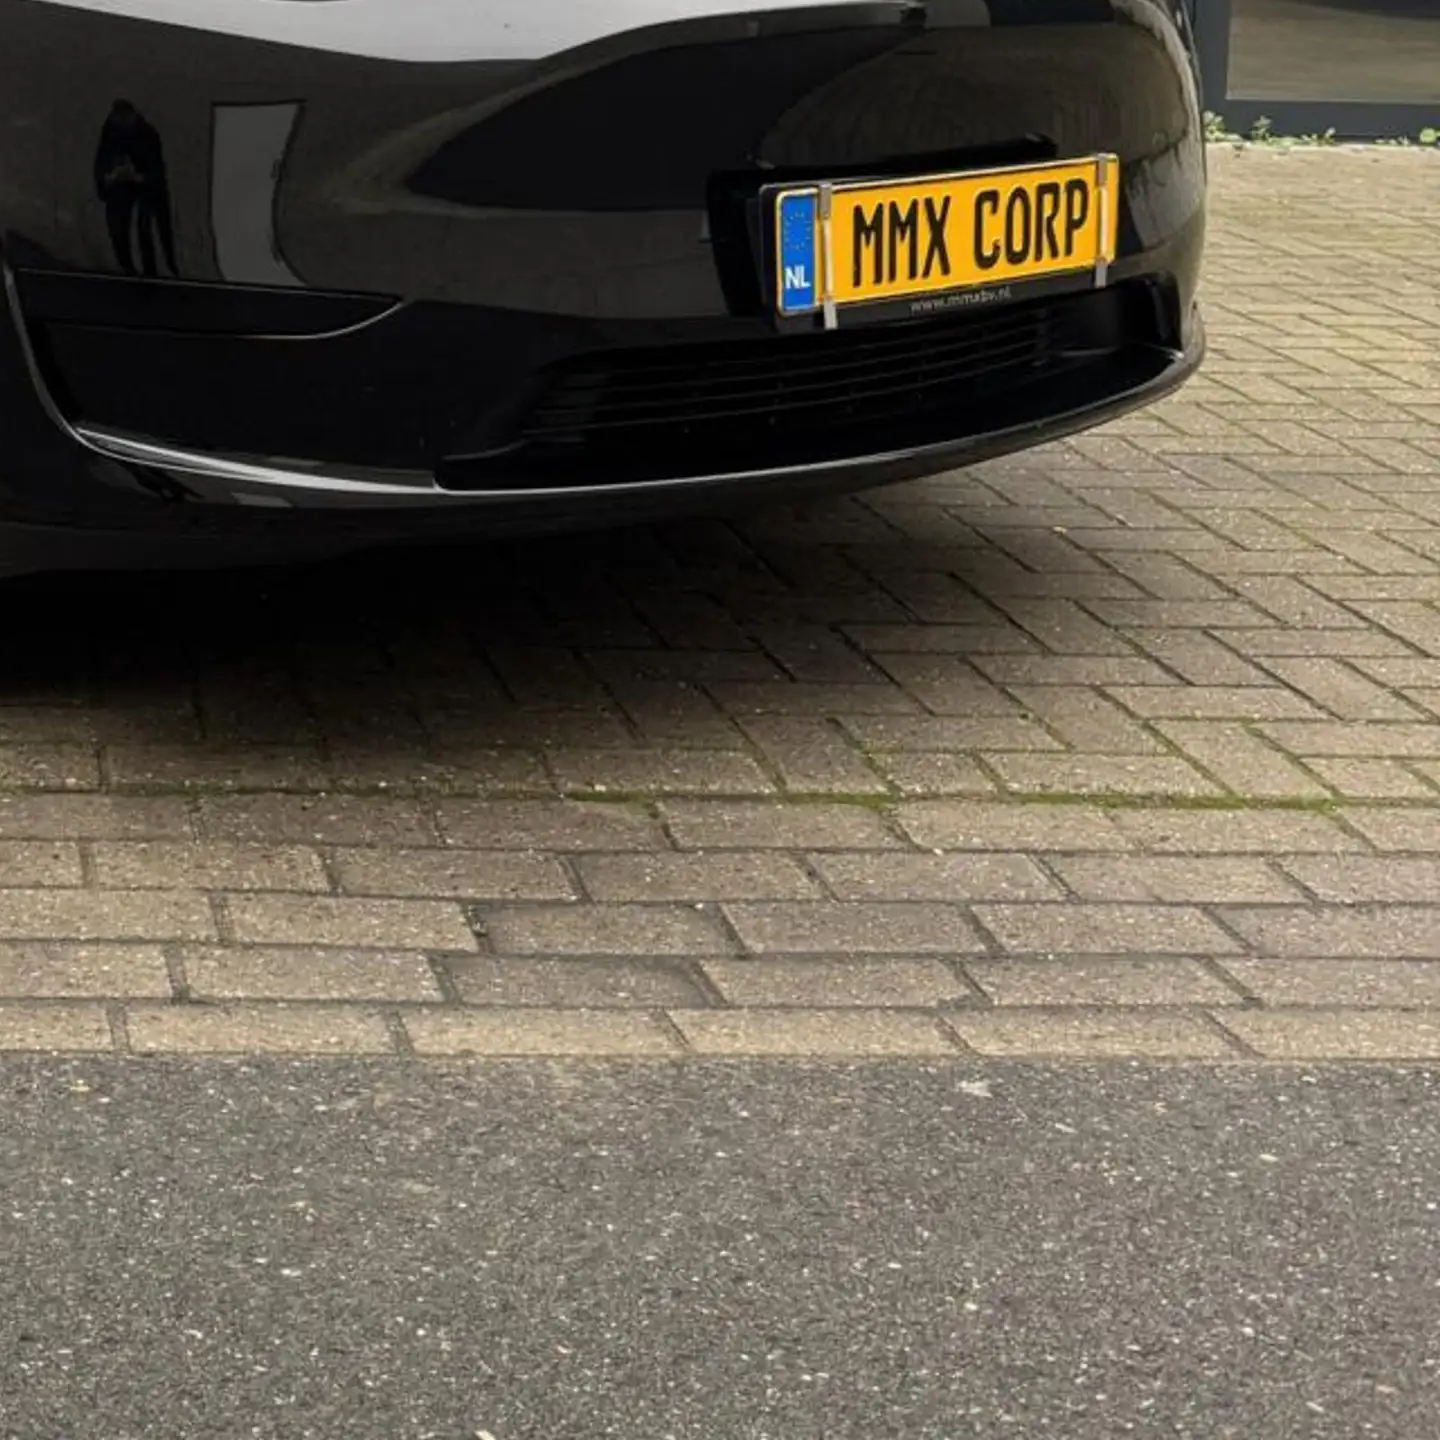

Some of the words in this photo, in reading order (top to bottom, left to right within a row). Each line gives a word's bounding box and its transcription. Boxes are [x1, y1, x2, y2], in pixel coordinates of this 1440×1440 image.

[852, 194, 952, 288] MMX
[973, 177, 1089, 270] CORP
[784, 266, 811, 290] NL
